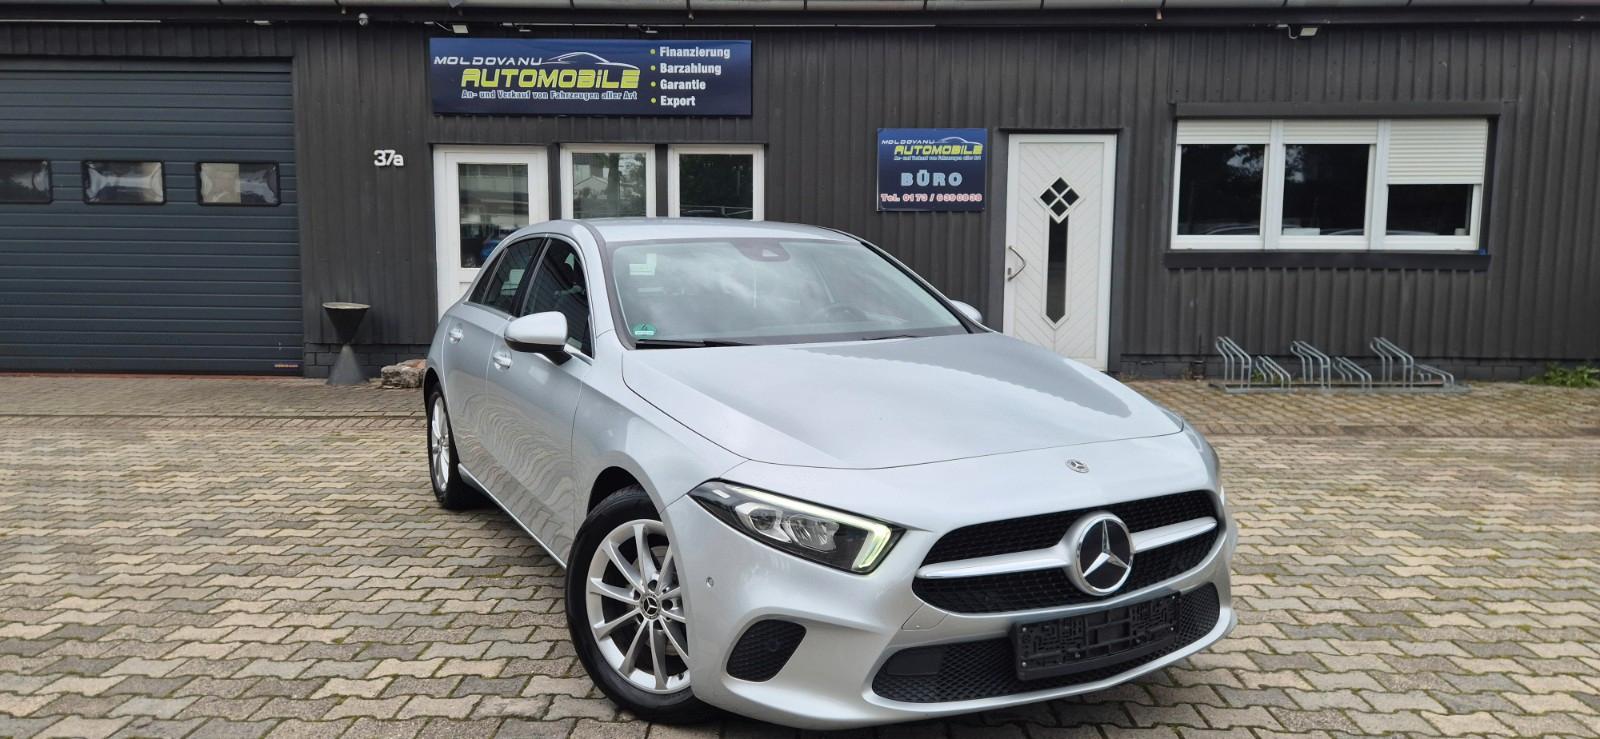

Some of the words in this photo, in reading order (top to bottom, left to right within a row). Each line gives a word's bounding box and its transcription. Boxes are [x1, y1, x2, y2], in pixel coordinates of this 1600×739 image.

[659, 46, 731, 59] Finanzierung
[433, 56, 542, 66] MOLDOVANU
[659, 62, 722, 75] Barzahlung
[660, 79, 706, 90] Garantie
[461, 90, 478, 99] An-
[479, 90, 496, 99] und
[497, 90, 530, 99] Verkauf
[532, 91, 548, 99] von
[549, 90, 600, 101] Fahrzeugen
[601, 90, 622, 100] aller
[623, 91, 638, 100] Art
[660, 95, 696, 108] Export
[373, 149, 404, 166] 37a
[901, 169, 963, 186] BÜRO
[880, 193, 901, 202] Tel.
